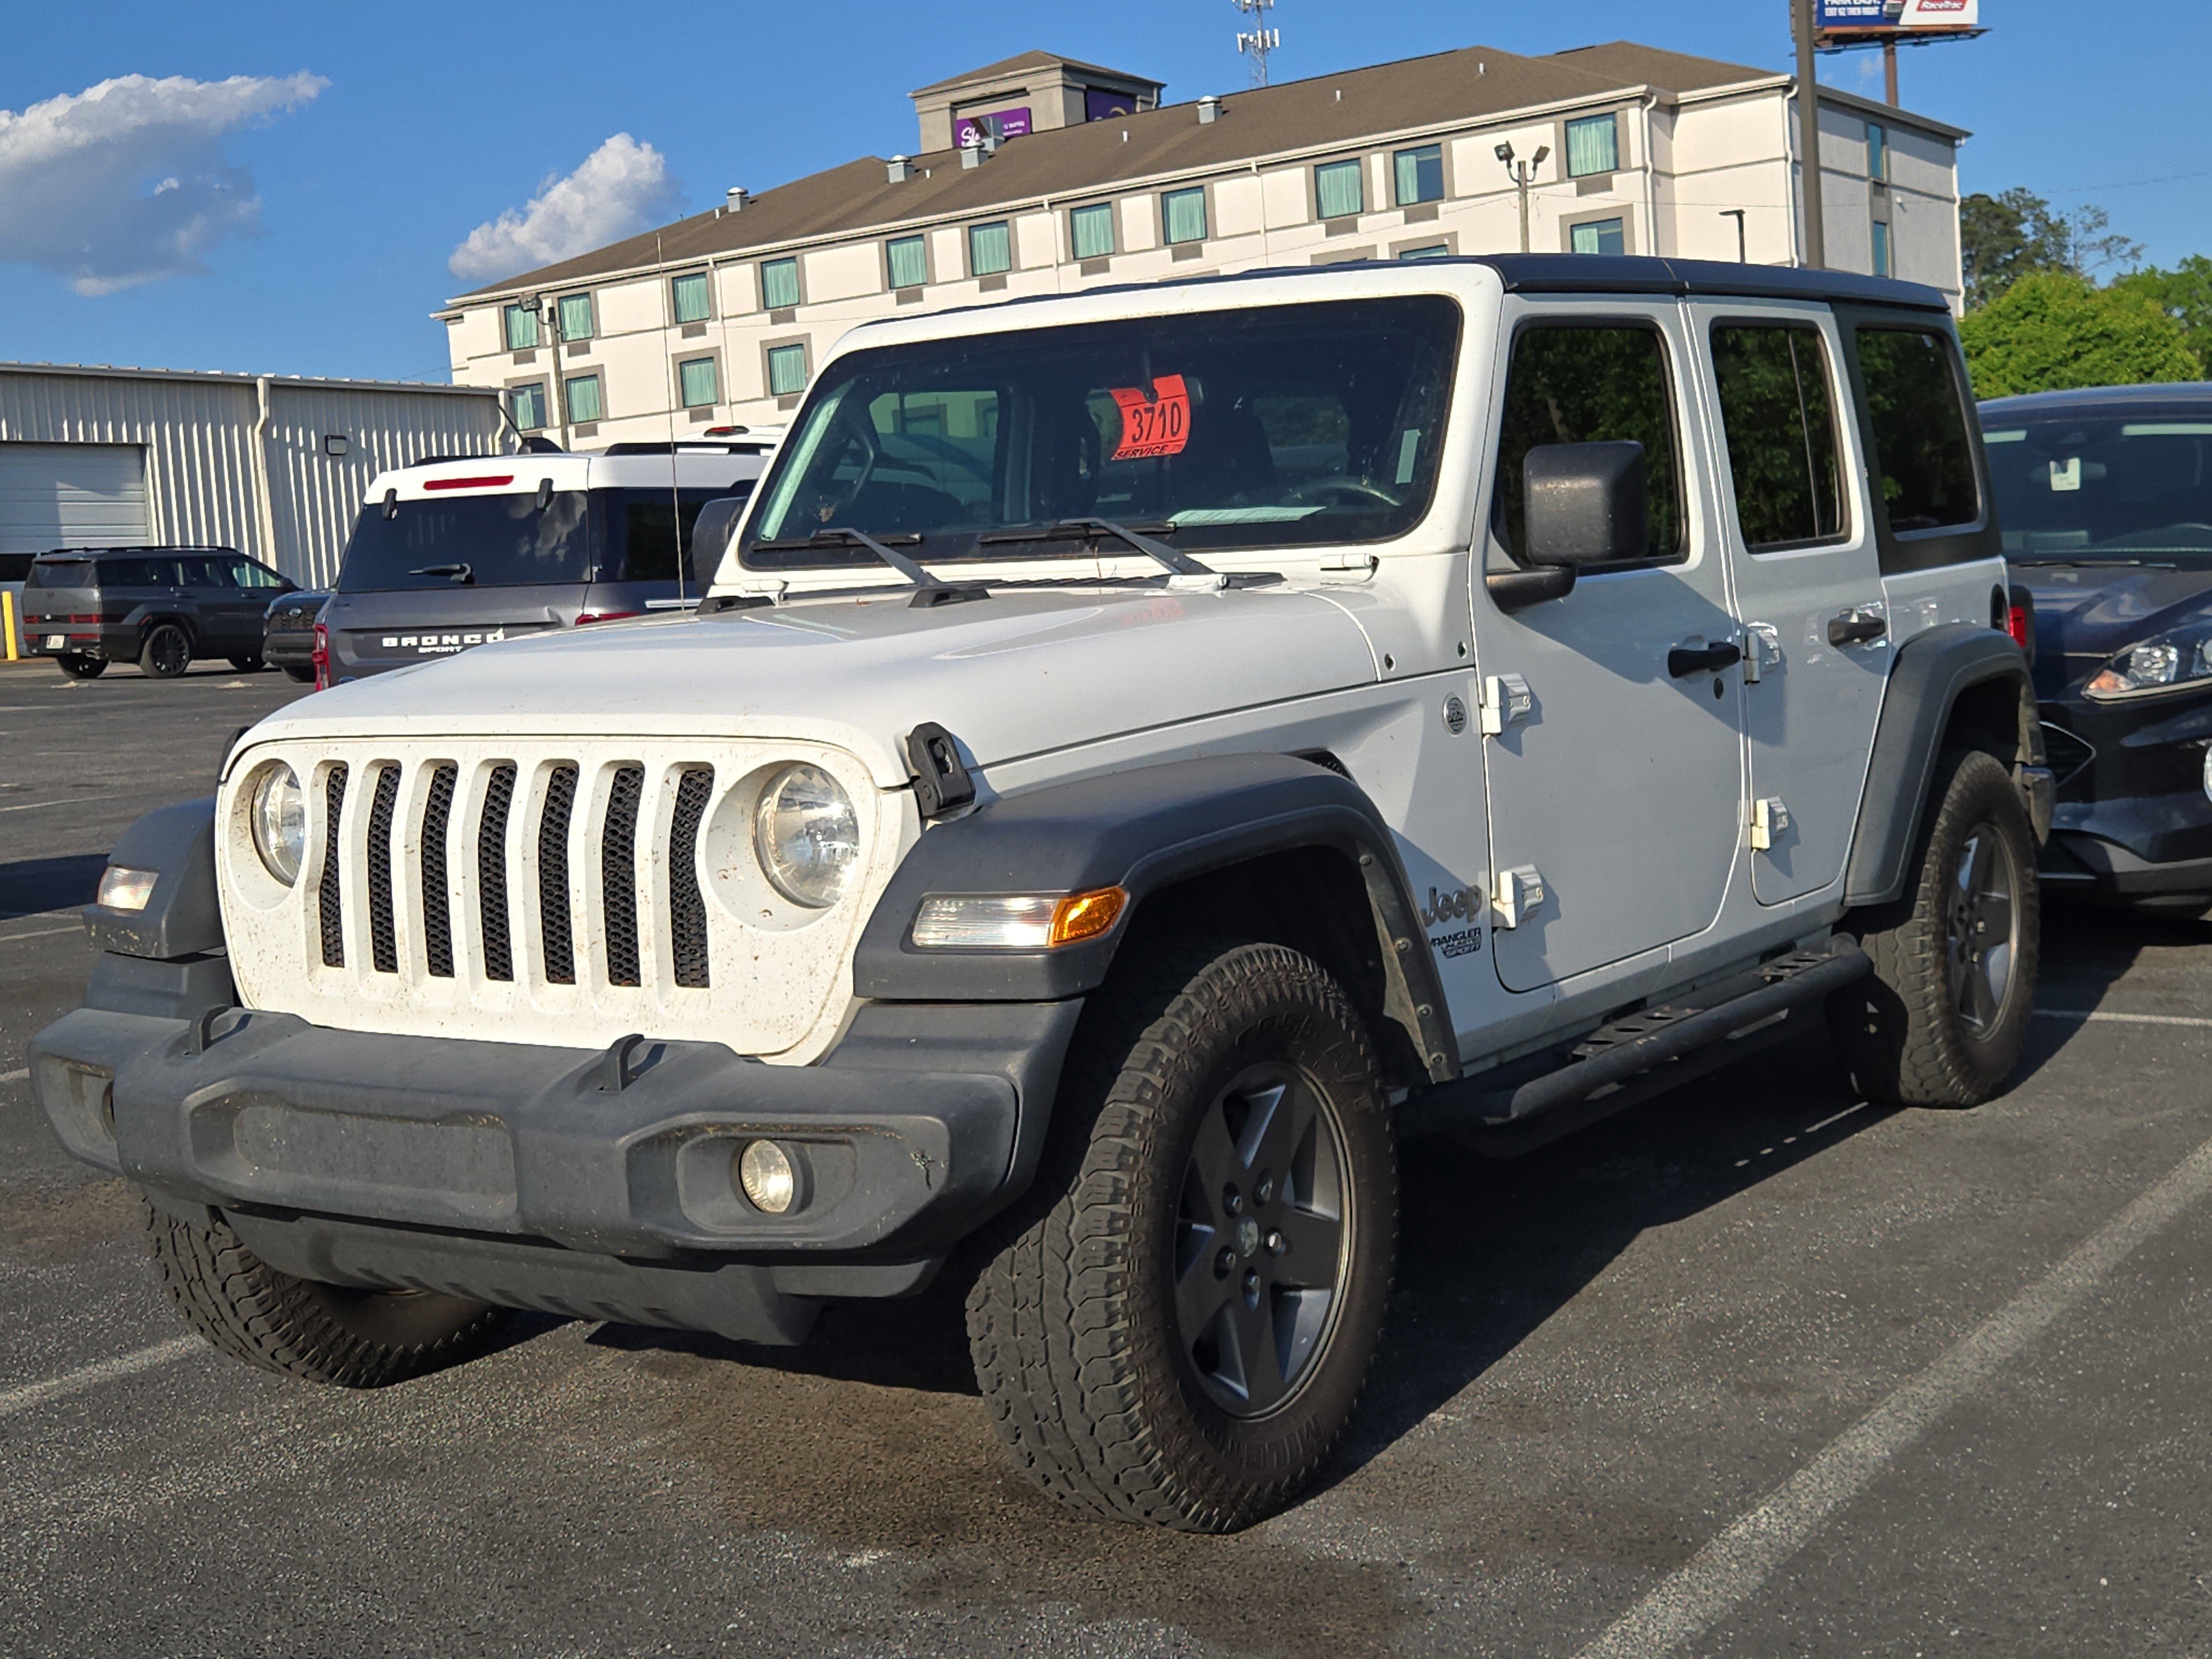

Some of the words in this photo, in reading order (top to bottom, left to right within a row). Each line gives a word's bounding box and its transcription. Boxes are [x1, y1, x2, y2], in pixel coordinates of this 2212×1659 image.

[1132, 401, 1182, 443] 3710
[1115, 445, 1169, 459] SERVICE
[382, 633, 504, 647] BRONCO
[1421, 885, 1482, 927] Jeep
